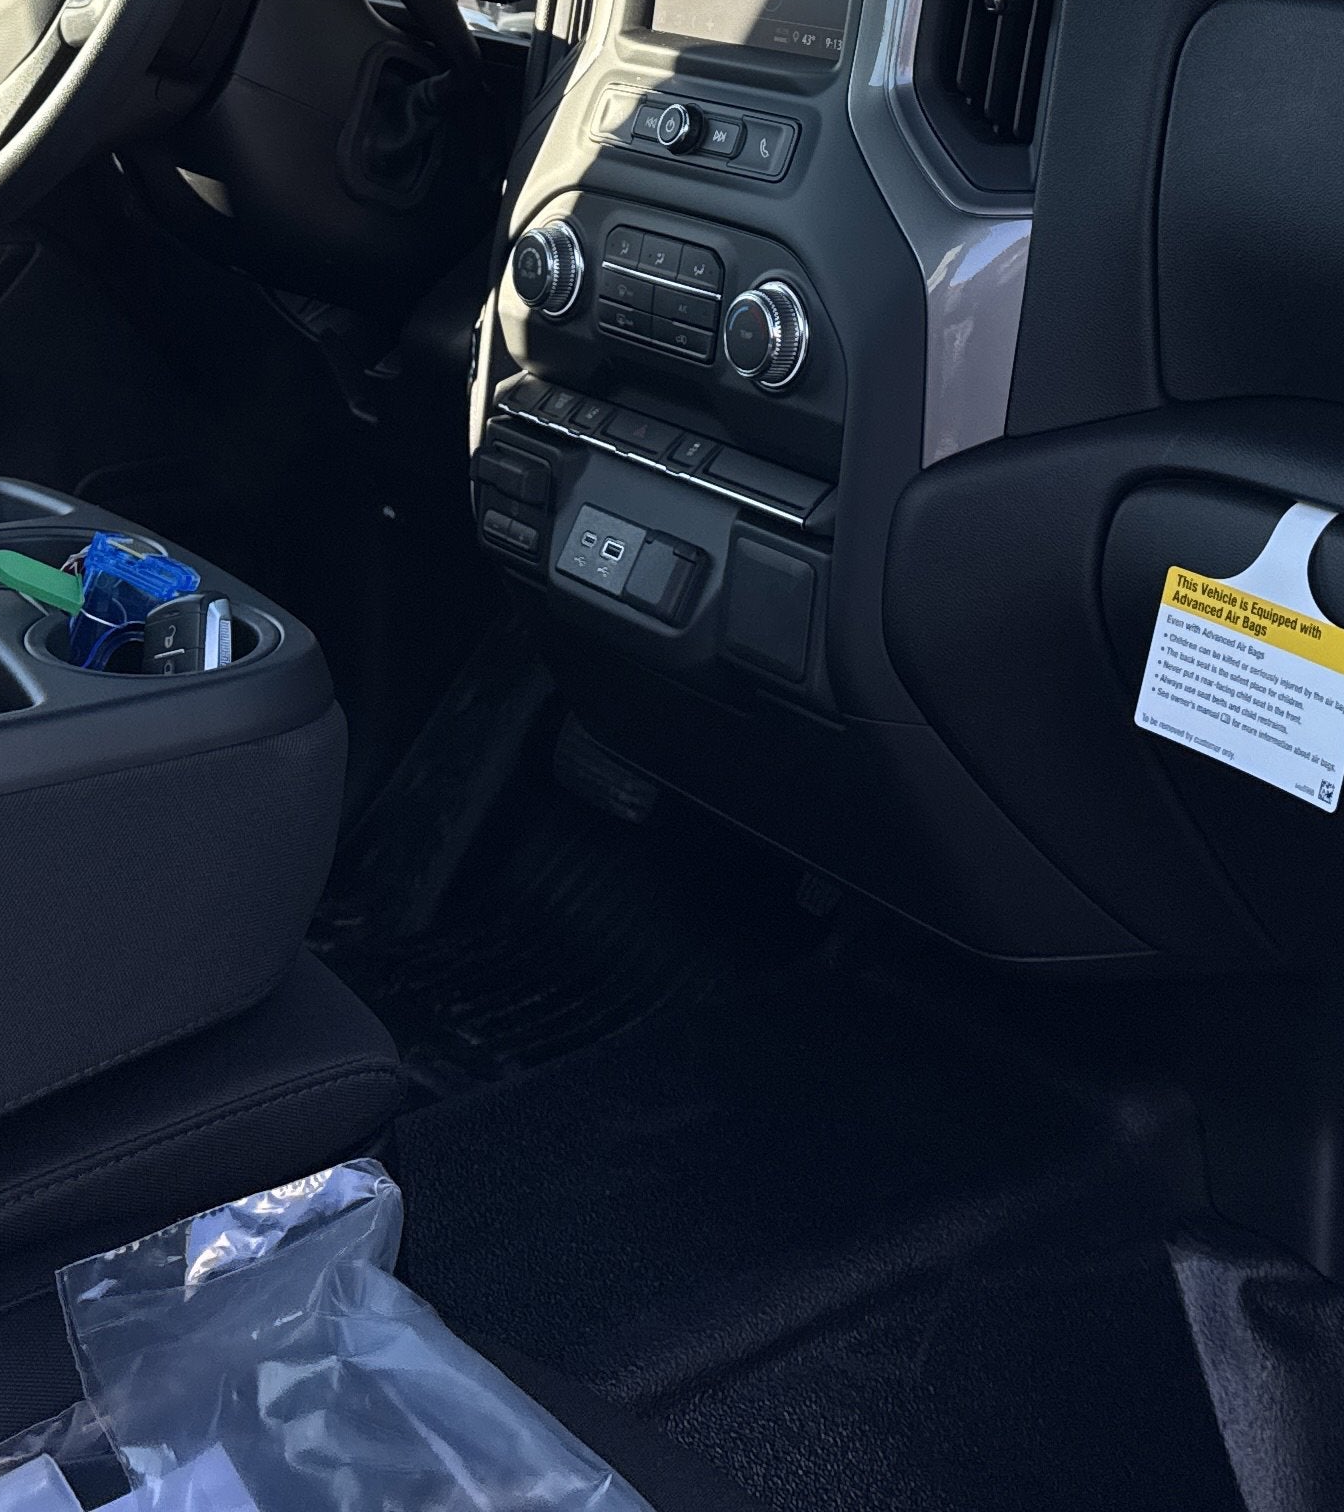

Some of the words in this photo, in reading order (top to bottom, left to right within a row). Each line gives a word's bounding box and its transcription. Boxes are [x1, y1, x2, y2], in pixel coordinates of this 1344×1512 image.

[1171, 588, 1224, 620] Advanced
[1224, 609, 1241, 627] Air
[1240, 615, 1268, 639] Bags
[1175, 573, 1199, 593] This
[1199, 582, 1238, 608] Vehicle
[1239, 597, 1249, 612] is
[1249, 601, 1298, 633] Equipped
[1298, 619, 1323, 641] with
